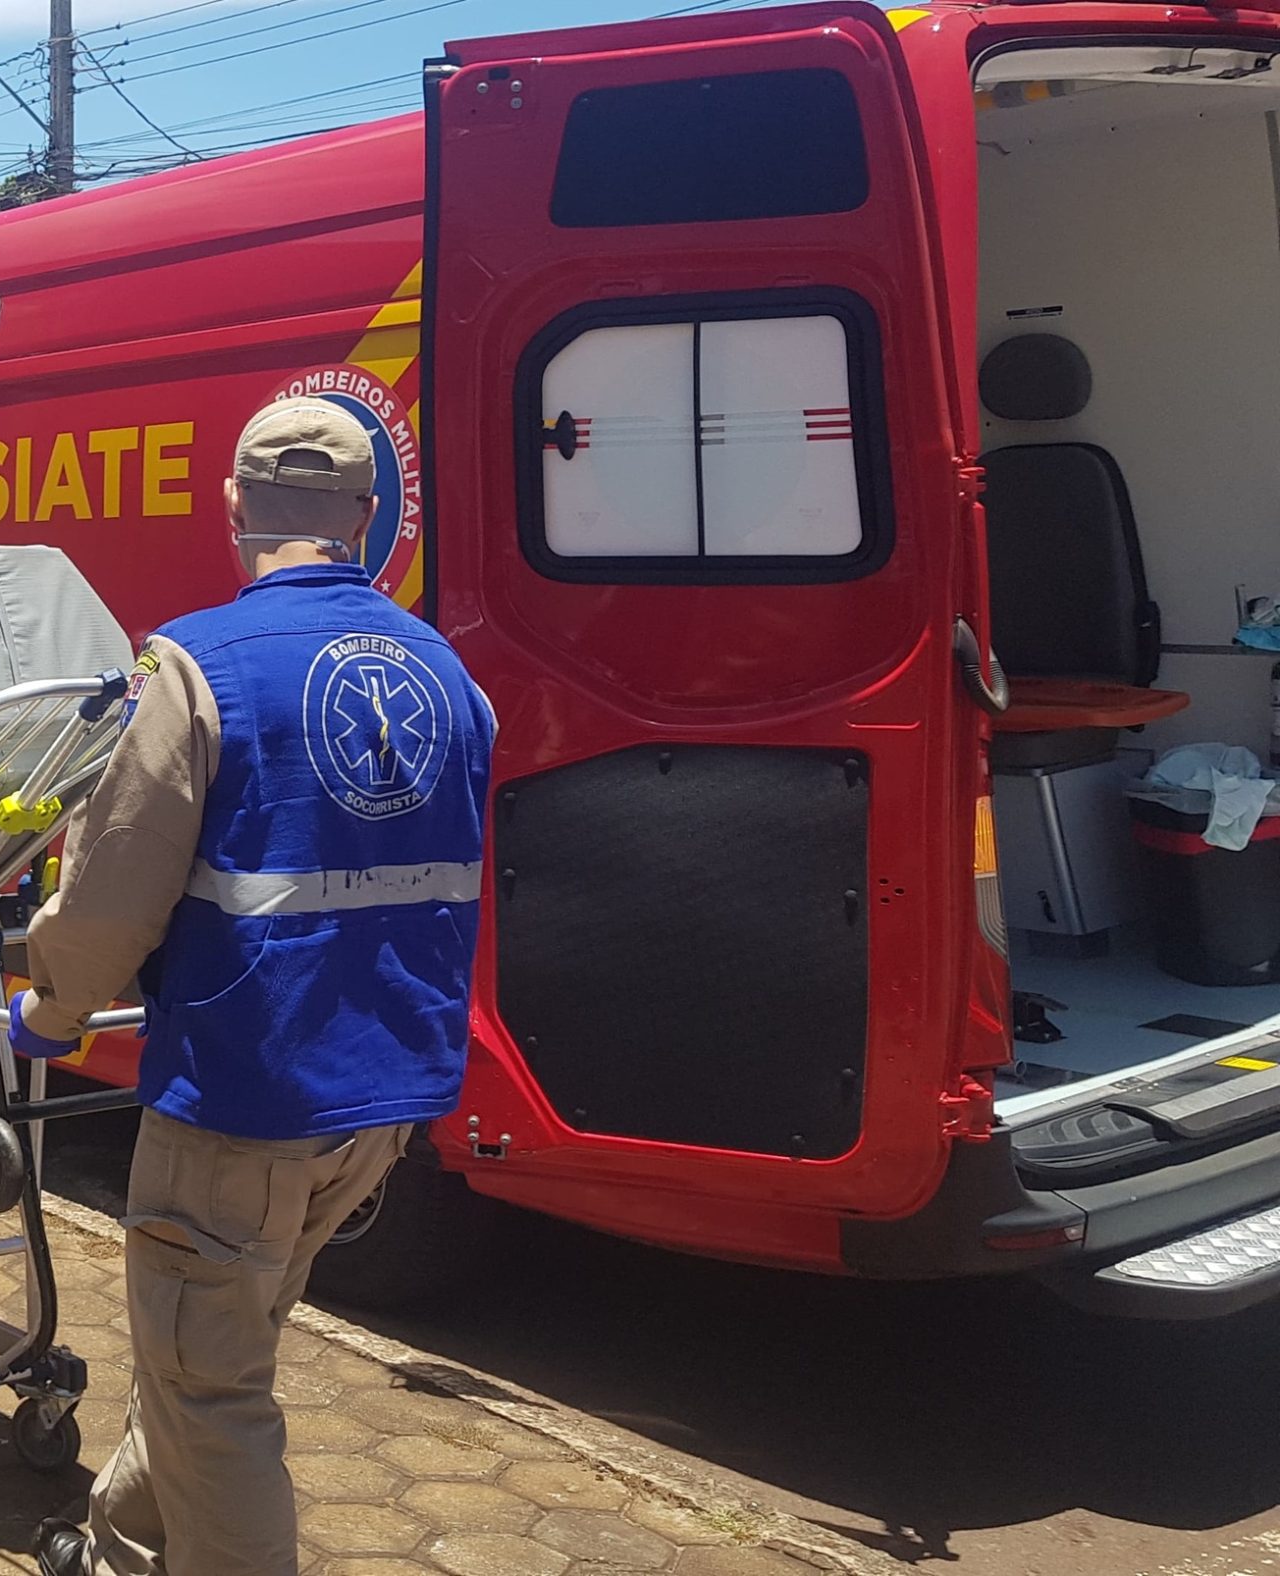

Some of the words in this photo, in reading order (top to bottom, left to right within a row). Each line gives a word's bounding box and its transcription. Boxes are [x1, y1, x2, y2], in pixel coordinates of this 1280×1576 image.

[391, 419, 421, 541] MILITAR
[328, 637, 406, 662] BOMBEIRO
[344, 791, 421, 814] SOCORRISTA
